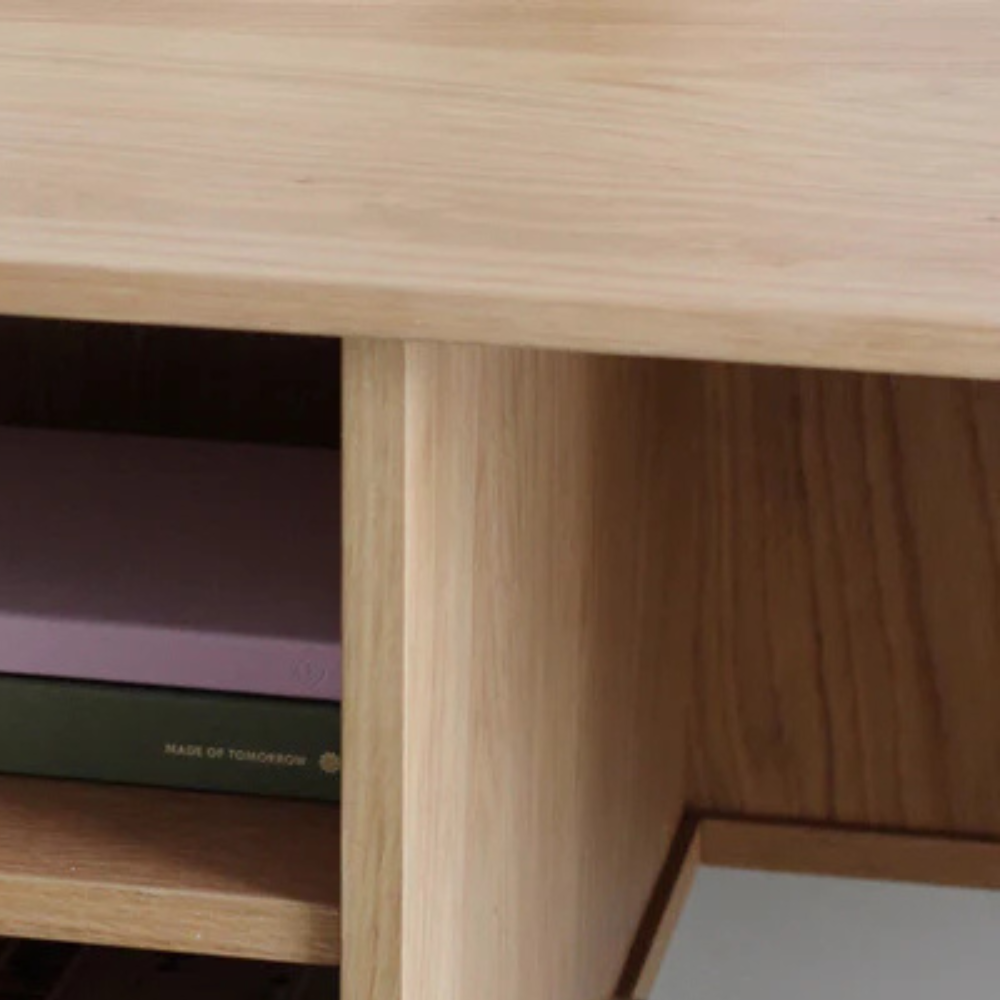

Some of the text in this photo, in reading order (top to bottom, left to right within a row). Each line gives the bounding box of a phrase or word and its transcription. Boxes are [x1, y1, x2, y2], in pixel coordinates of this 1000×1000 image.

[164, 743, 307, 766] MADE OF TOMORROW
